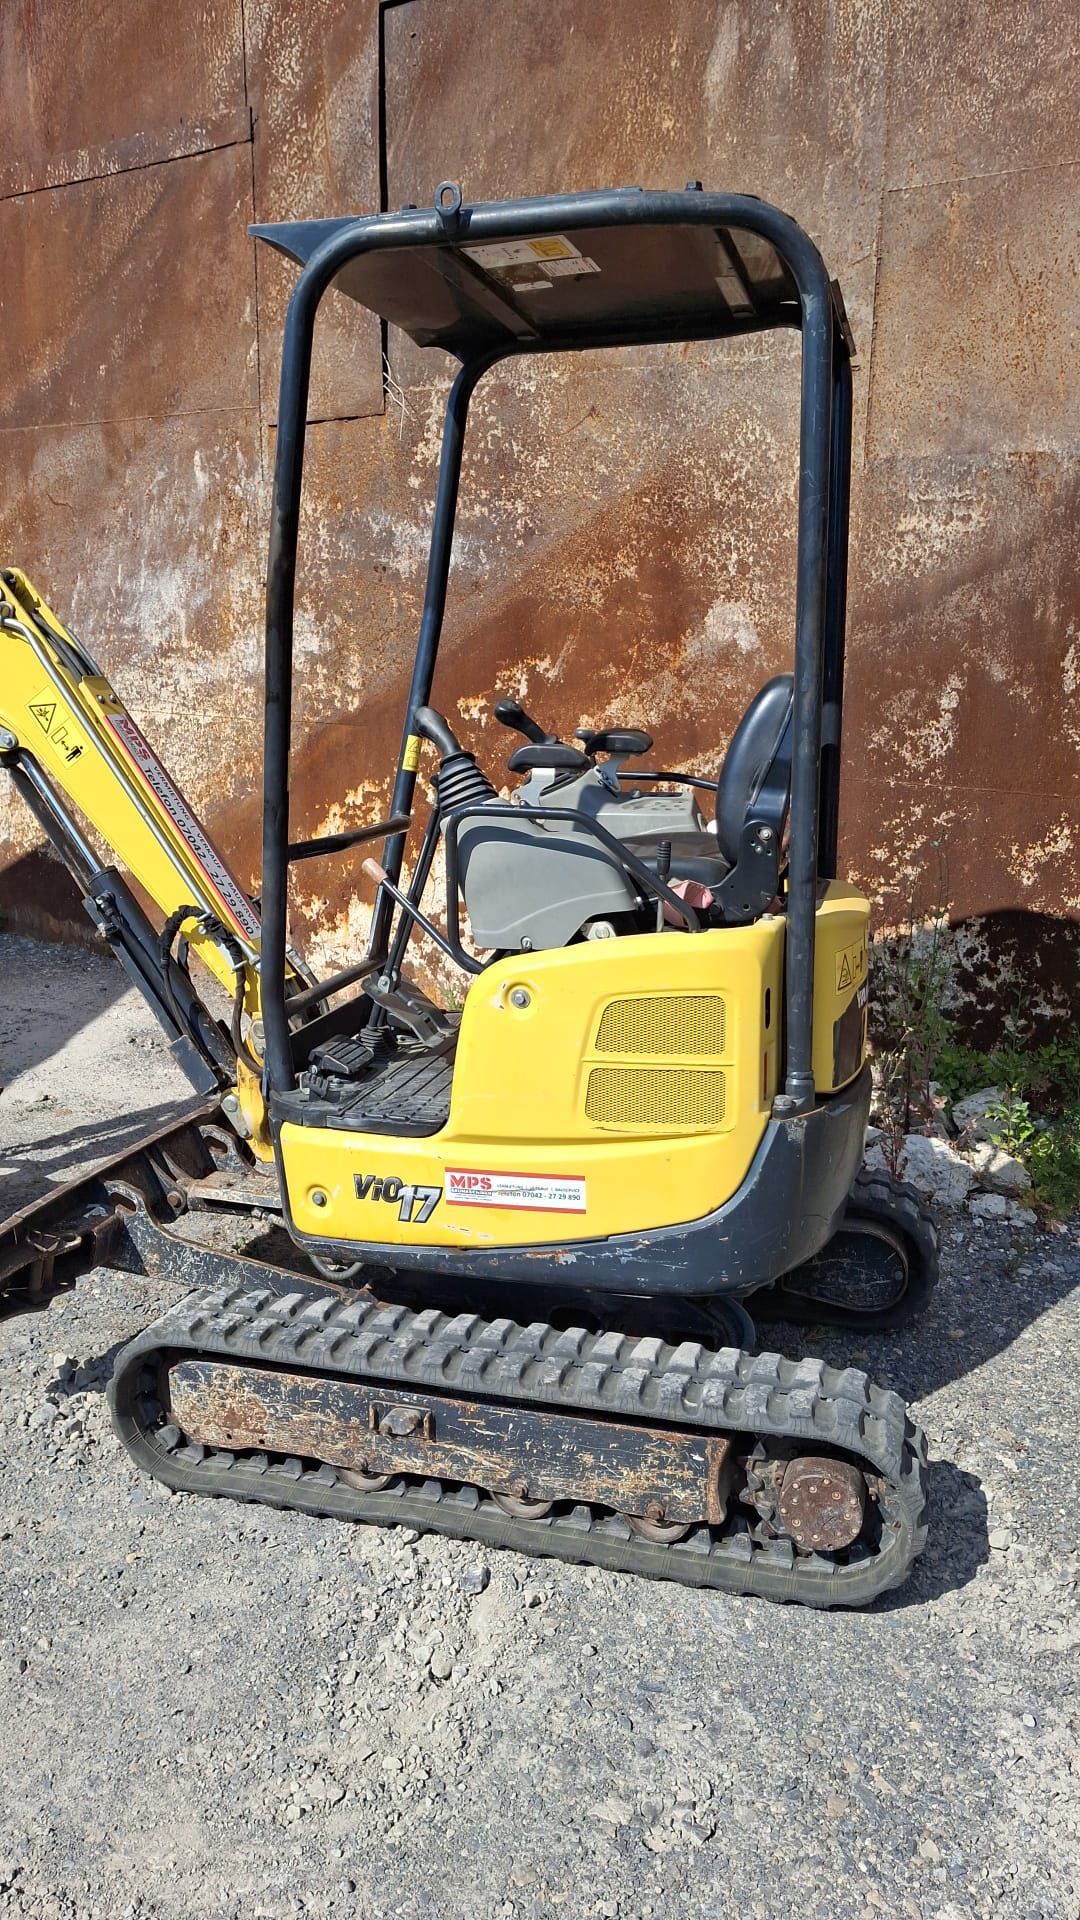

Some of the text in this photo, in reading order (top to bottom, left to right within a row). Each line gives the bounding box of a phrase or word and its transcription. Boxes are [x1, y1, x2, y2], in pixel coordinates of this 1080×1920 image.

[115, 719, 150, 760] MPS
[153, 766, 190, 820] VERMIETUNG
[196, 832, 221, 868] VERKAUF
[145, 768, 177, 816] Telefon
[177, 819, 206, 859] 07042
[210, 871, 225, 887] 27
[222, 891, 237, 907] 29
[236, 910, 254, 935] 890
[450, 1175, 492, 1190] MPS
[522, 1191, 543, 1199] 07042
